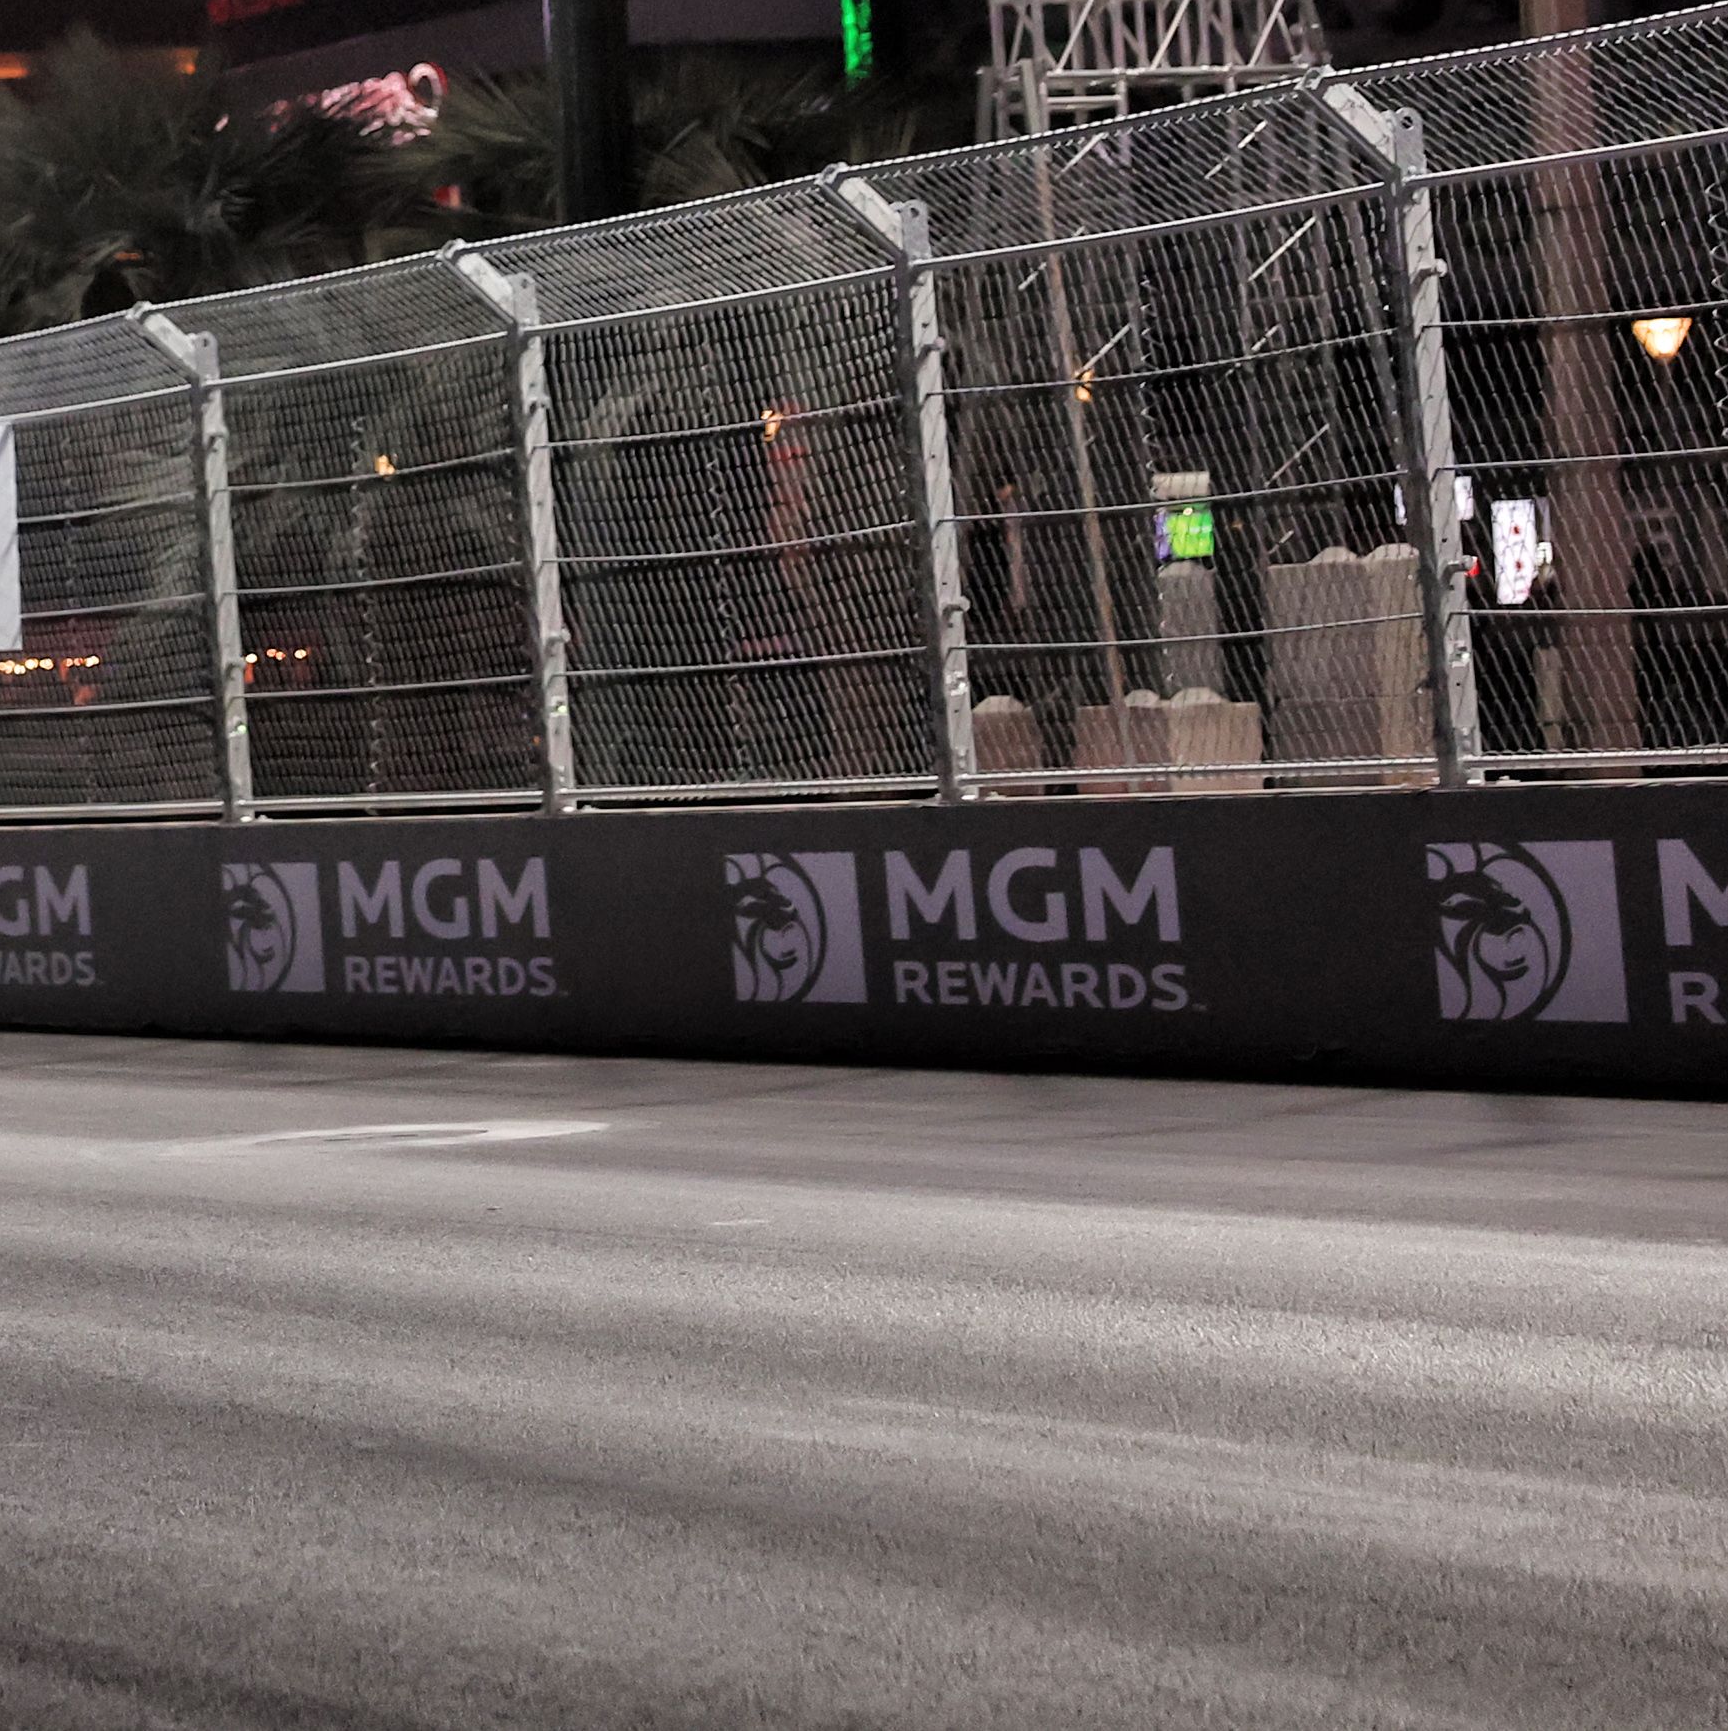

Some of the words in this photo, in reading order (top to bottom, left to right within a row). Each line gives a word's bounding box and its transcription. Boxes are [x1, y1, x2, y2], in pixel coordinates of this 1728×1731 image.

[337, 856, 552, 940] MGM
[884, 845, 1182, 943] MGM
[344, 956, 559, 998] REWARDS
[893, 960, 1191, 1012] REWARDS
